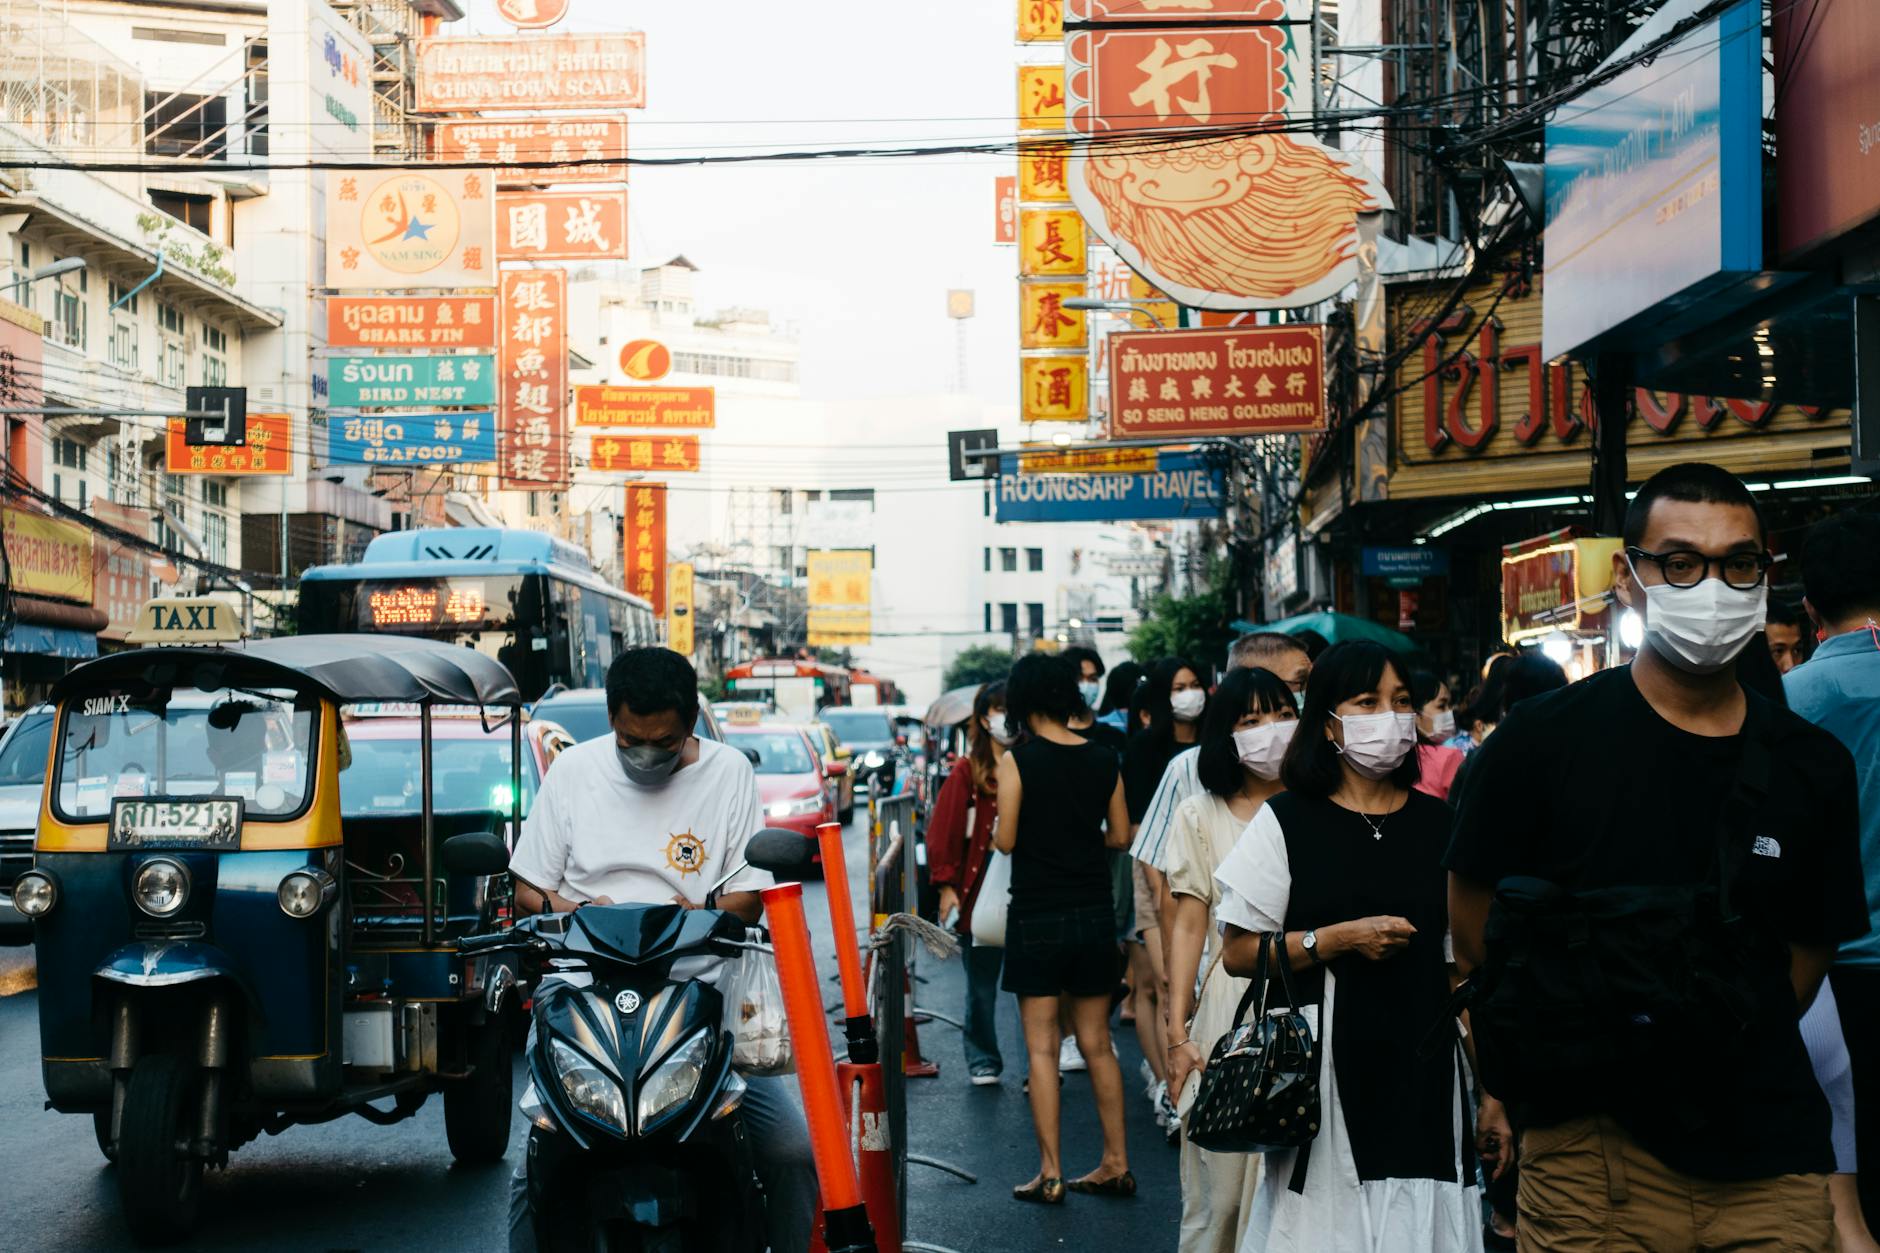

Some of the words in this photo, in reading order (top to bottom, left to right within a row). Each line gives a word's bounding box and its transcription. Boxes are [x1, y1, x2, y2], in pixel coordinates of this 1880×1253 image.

[432, 81, 494, 99] CHINA
[500, 80, 560, 98] TOWN
[566, 79, 633, 97] SCALA
[1128, 38, 1239, 124] 行
[508, 198, 611, 252] 國城
[380, 251, 409, 261] NAM
[412, 250, 443, 260] SING
[342, 303, 425, 331] หูฉลาม
[358, 328, 426, 343] SHARK
[430, 328, 465, 343] FIN
[342, 358, 414, 383] รังนก
[1120, 347, 1218, 373] ห้างขายทอง
[358, 387, 408, 402] BIRD
[413, 386, 466, 401] NEST
[1122, 408, 1143, 424] SO
[1147, 406, 1185, 423] SENG
[1189, 405, 1229, 421] HENG
[1233, 402, 1315, 420] GOLDSMITH
[362, 446, 463, 462] SEAFOOD
[596, 438, 690, 469] 中國城
[1001, 474, 1134, 503] ROONGSARP
[1142, 470, 1218, 499] TRAVEL
[150, 605, 217, 630] TAXI
[446, 590, 482, 621] 40
[84, 696, 114, 716] SIAM
[116, 694, 130, 712] X
[167, 802, 232, 831] 5213
